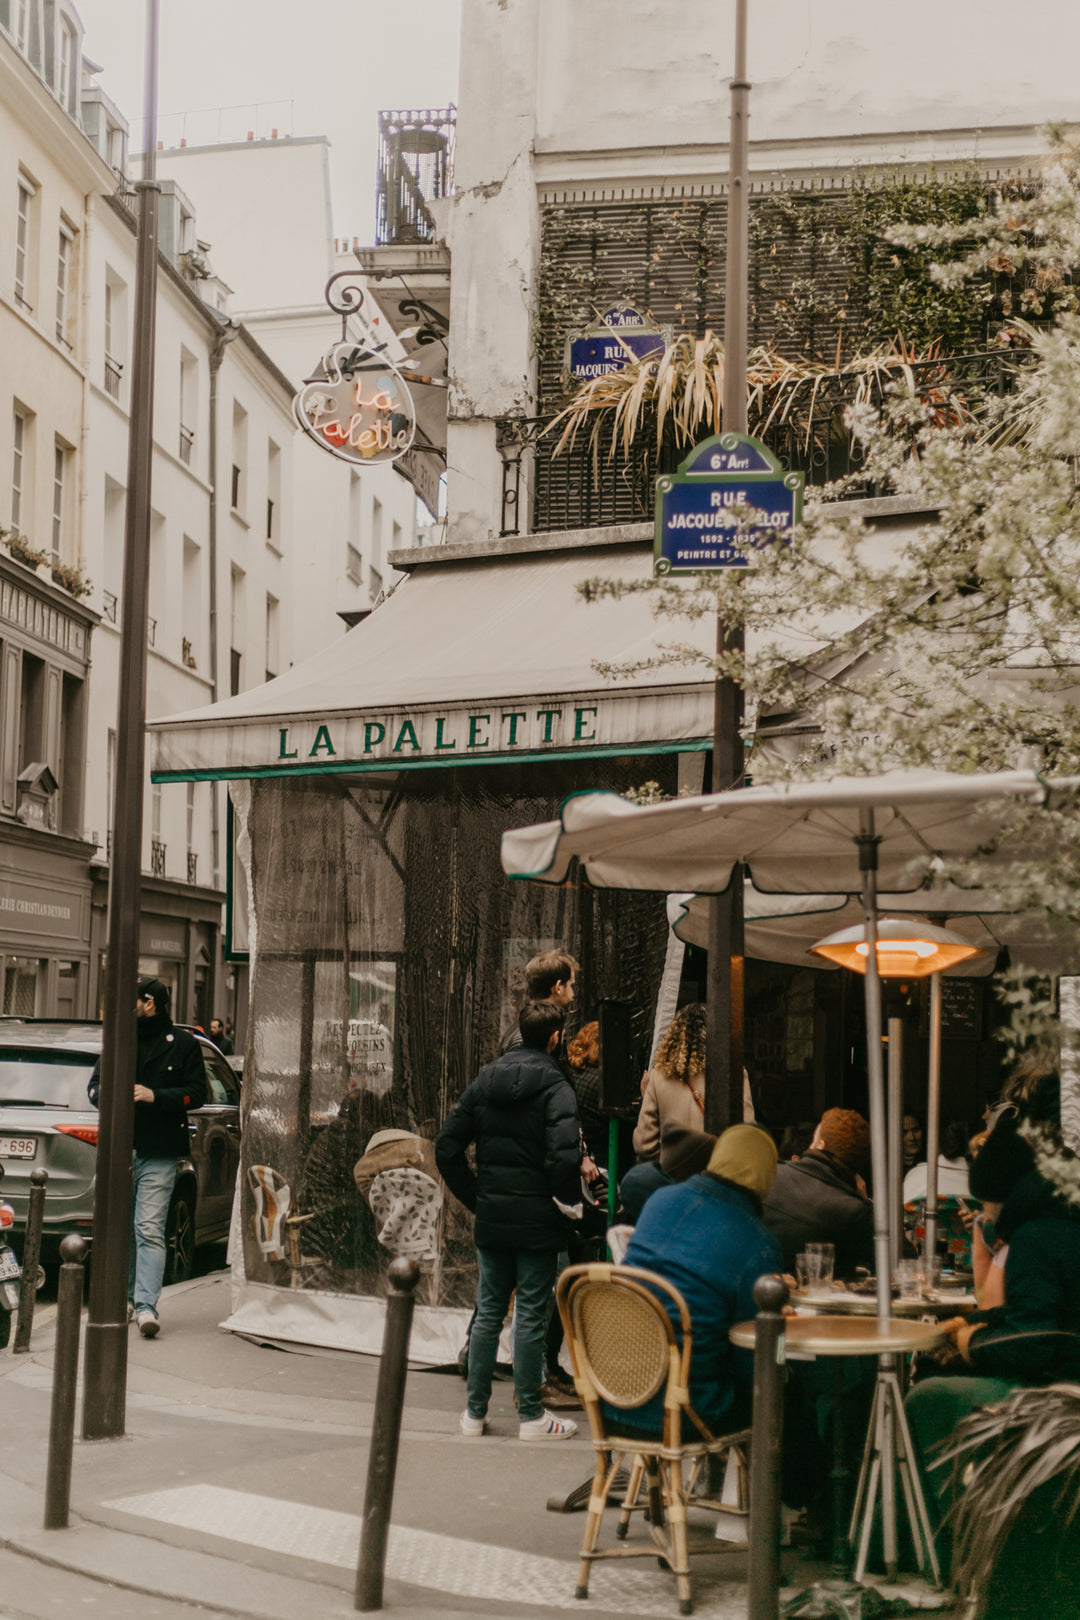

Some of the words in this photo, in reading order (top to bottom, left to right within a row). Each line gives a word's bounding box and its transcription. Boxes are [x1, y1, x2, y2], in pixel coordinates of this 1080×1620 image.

[575, 363, 618, 377] JACQUES
[356, 376, 400, 410] La
[710, 491, 747, 506] RUE
[667, 513, 730, 529] JACQUE
[700, 534, 723, 543] 1592
[677, 550, 717, 559] PEINTRE
[719, 549, 732, 559] ET
[278, 725, 336, 759] LA
[362, 707, 597, 754] PALETTE
